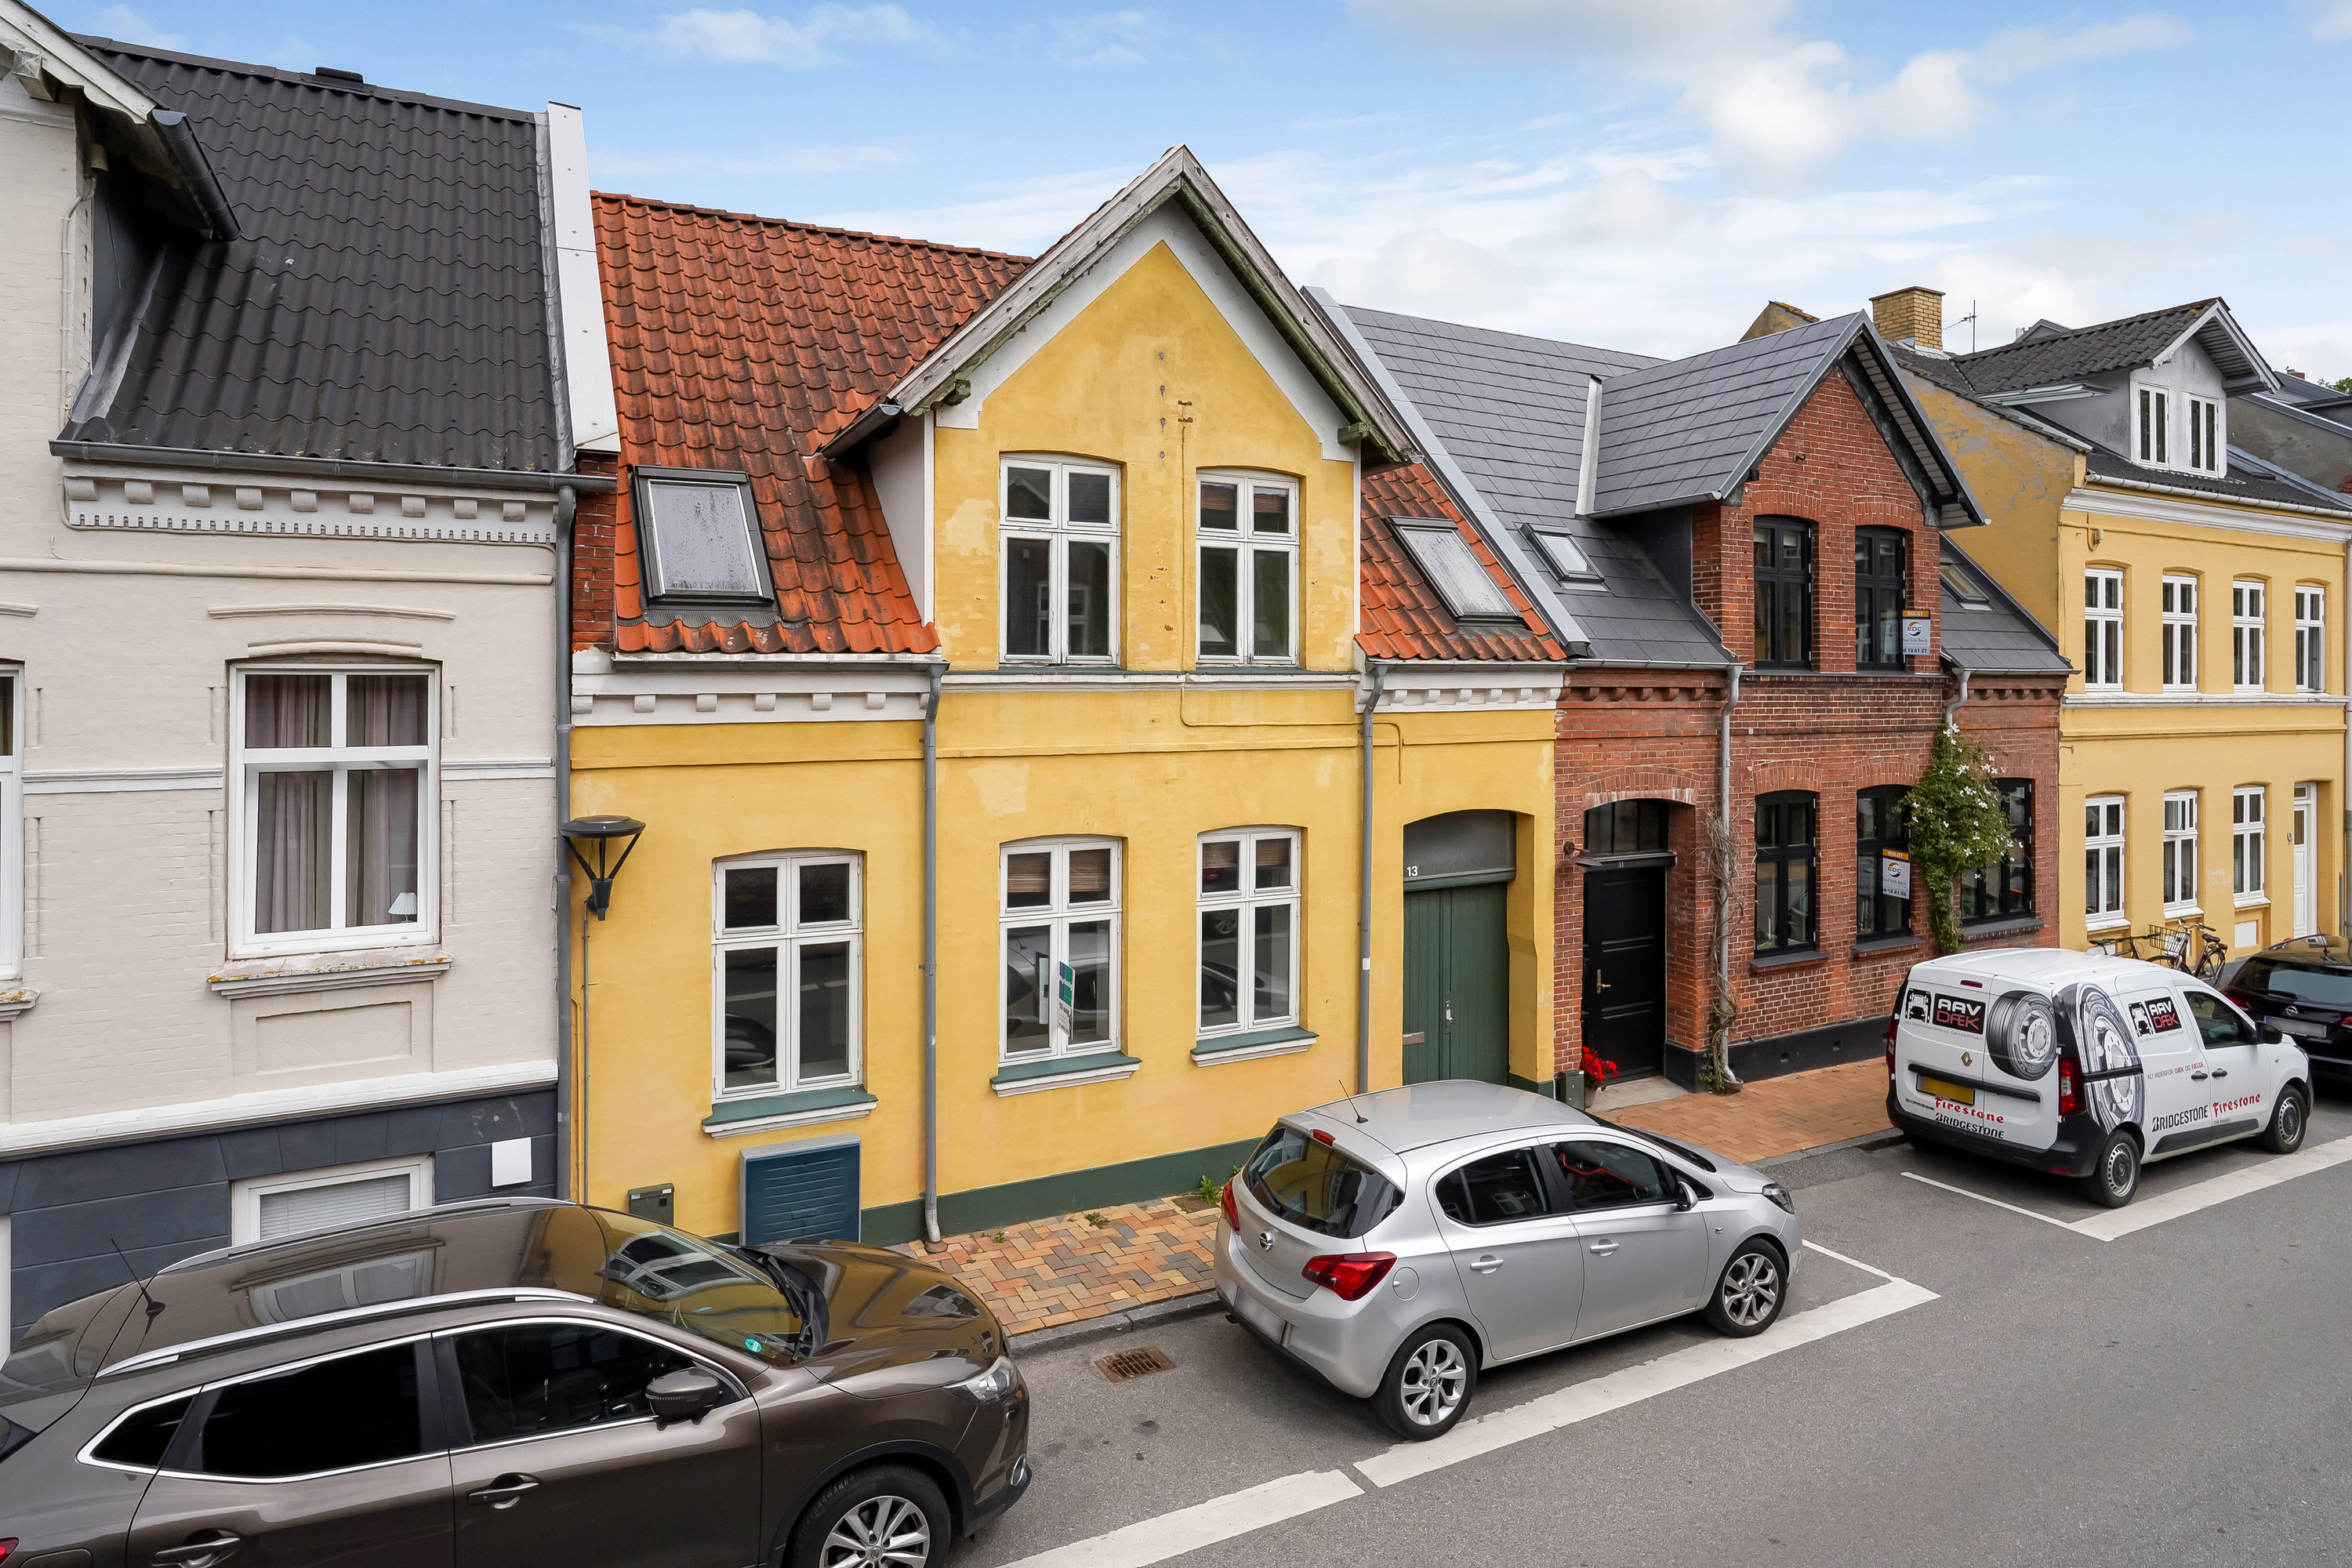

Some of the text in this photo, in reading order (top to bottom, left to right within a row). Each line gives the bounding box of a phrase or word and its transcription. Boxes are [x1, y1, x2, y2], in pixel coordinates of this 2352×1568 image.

[1407, 866, 1417, 877] 13
[1938, 999, 1981, 1016] AAV
[2148, 1001, 2172, 1016] AAV
[1936, 1010, 1979, 1030] DÆK
[2153, 1013, 2179, 1029] DÆK
[2154, 1069, 2173, 1078] INDENFOR
[1935, 1098, 2004, 1123] Firestone
[2212, 1093, 2260, 1117] Firestone
[1935, 1112, 2005, 1138] BRIDGESTONE
[2151, 1105, 2208, 1132] BRIDGESTONE
